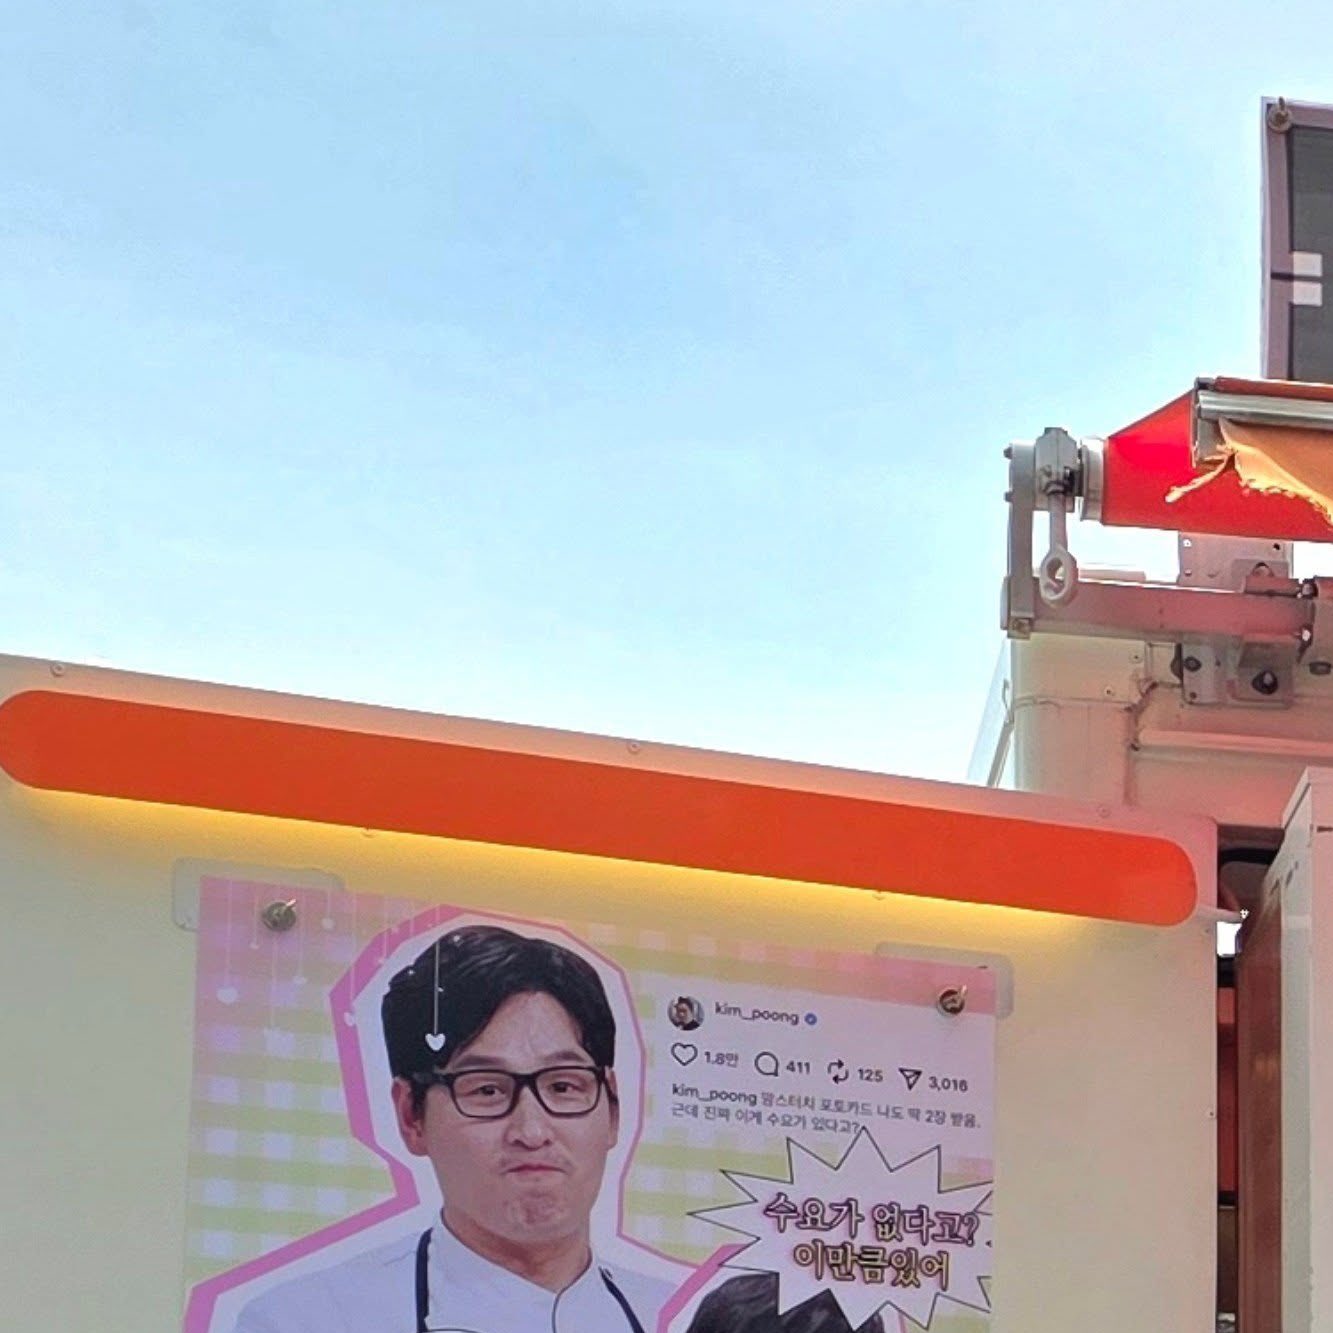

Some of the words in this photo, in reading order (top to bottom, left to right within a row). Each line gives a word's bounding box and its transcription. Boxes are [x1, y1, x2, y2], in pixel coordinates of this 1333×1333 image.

[714, 1002, 800, 1026] kim_poong
[704, 1051, 739, 1067] 1.8만
[786, 1061, 811, 1075] 411
[857, 1068, 884, 1082] 125
[671, 1102, 699, 1118] 근데
[767, 1112, 807, 1130] 수요가
[672, 1083, 757, 1107] kim_poong
[877, 1104, 904, 1119] 나도
[764, 1192, 866, 1239] 수요가
[872, 1201, 980, 1247] 없다고?
[793, 1239, 949, 1292] 이만큼있어
